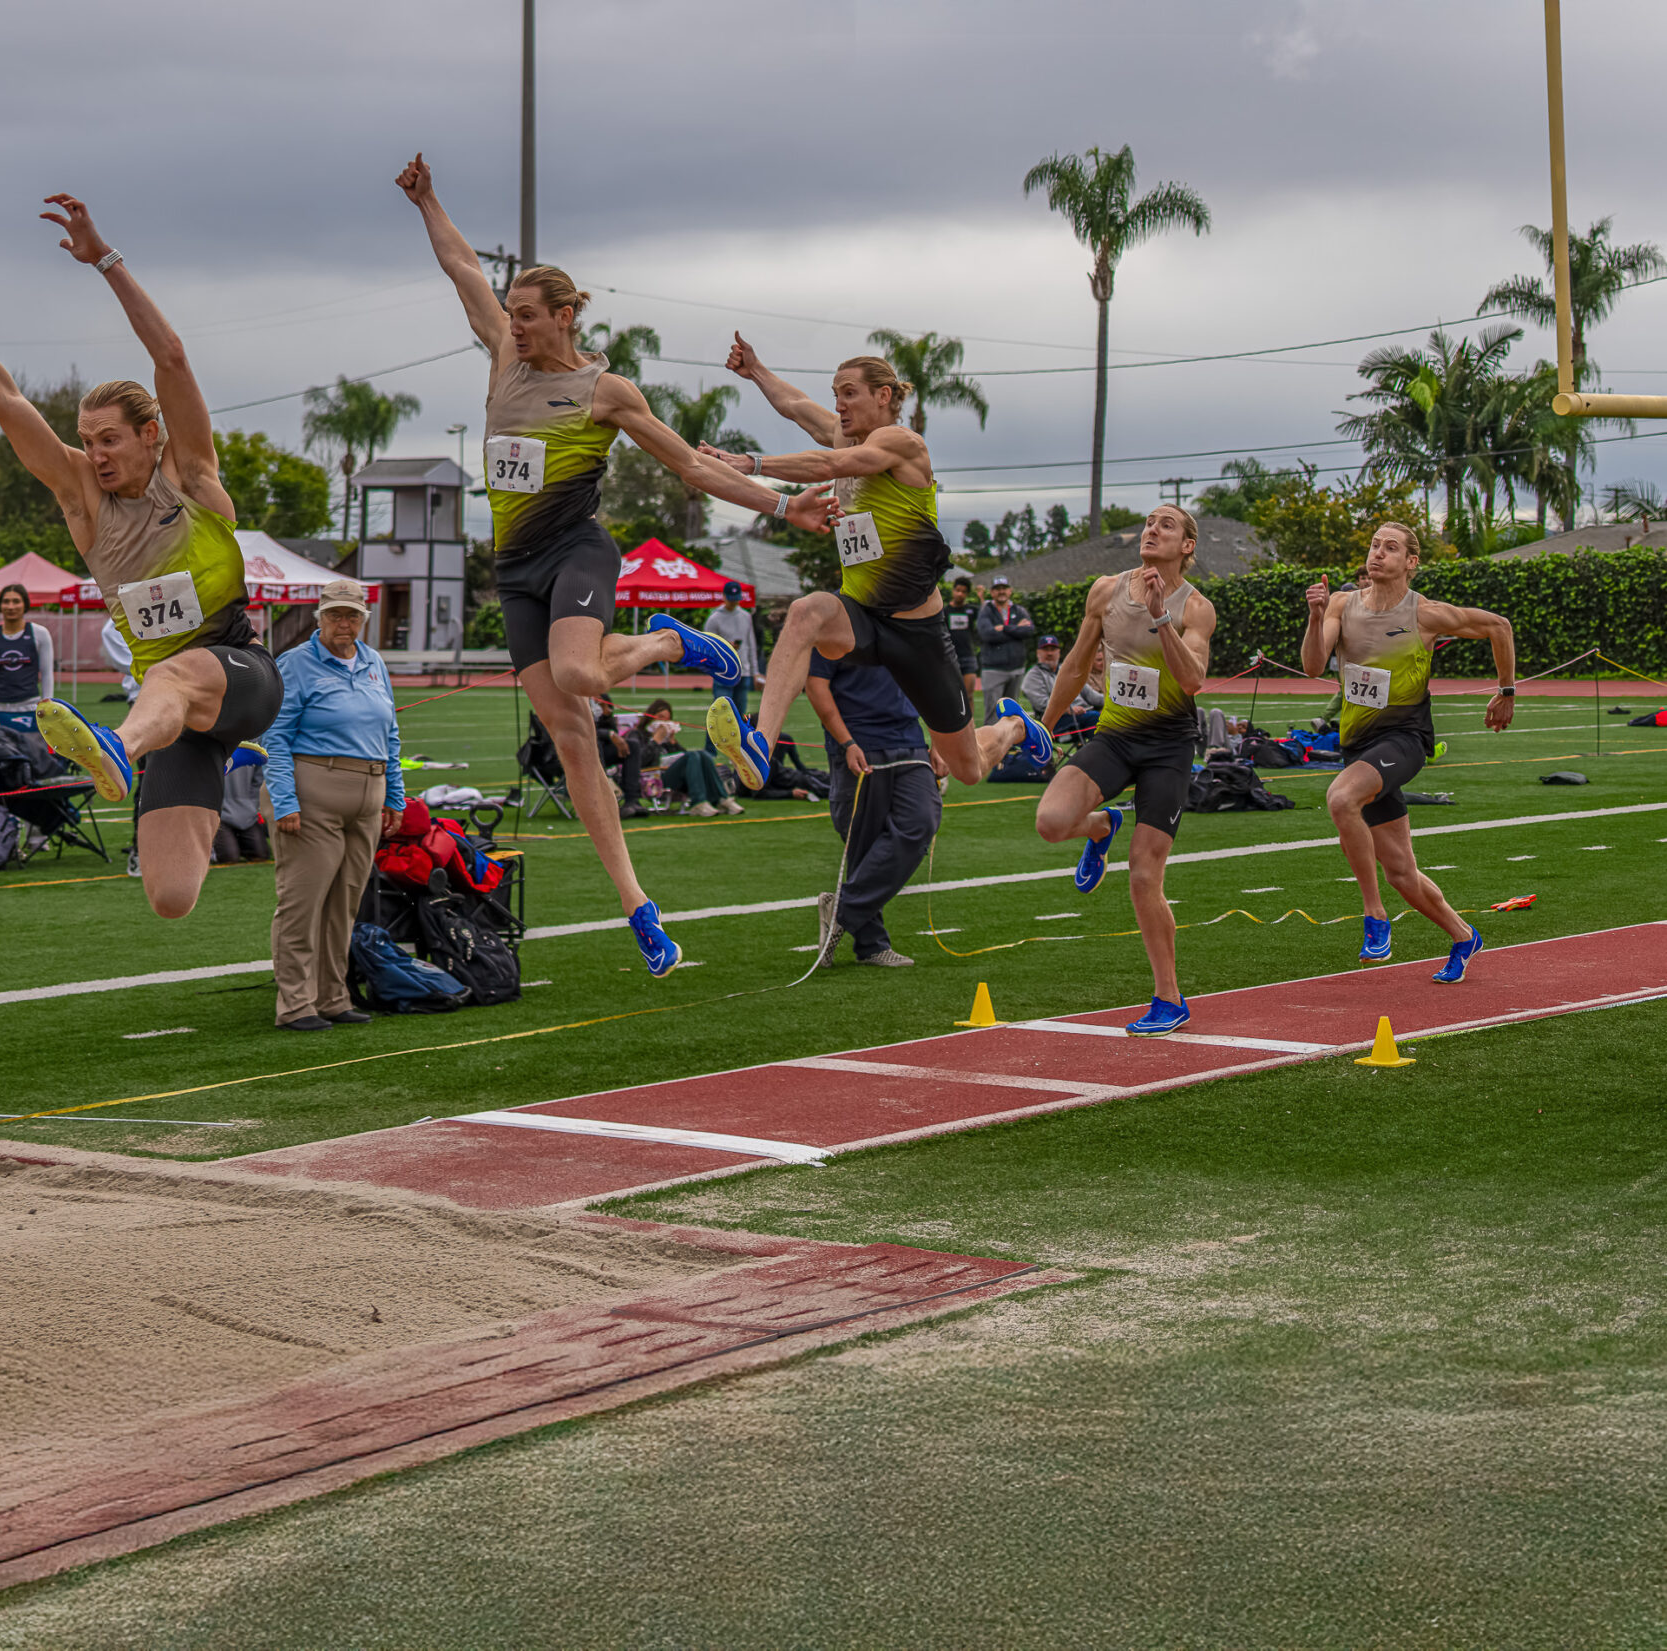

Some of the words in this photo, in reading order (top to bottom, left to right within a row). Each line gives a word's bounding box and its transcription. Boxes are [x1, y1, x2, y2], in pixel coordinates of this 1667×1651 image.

[496, 459, 530, 481] 374
[842, 534, 870, 556] 374
[138, 599, 184, 628] 374
[1117, 681, 1147, 700] 374
[1350, 681, 1378, 699] 374
